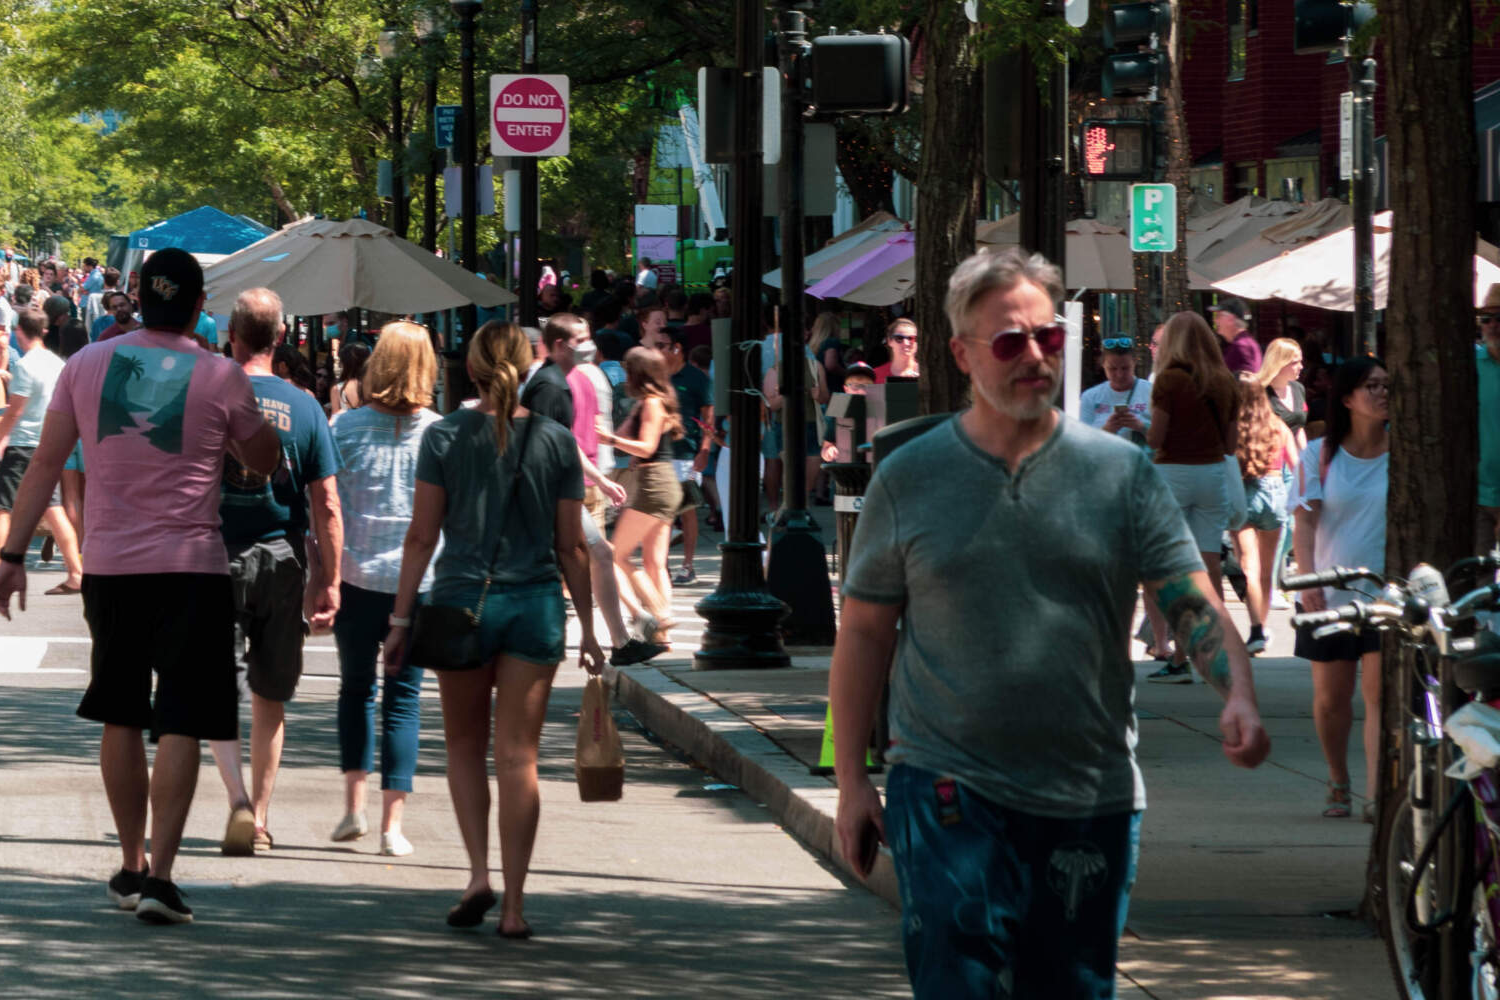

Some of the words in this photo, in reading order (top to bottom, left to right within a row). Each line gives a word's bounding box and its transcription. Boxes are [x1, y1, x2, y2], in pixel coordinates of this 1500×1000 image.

[502, 93, 524, 106] DO
[528, 94, 557, 107] NOT
[506, 124, 552, 137] ENTER
[1143, 188, 1164, 211] P
[261, 397, 292, 414] HAVE
